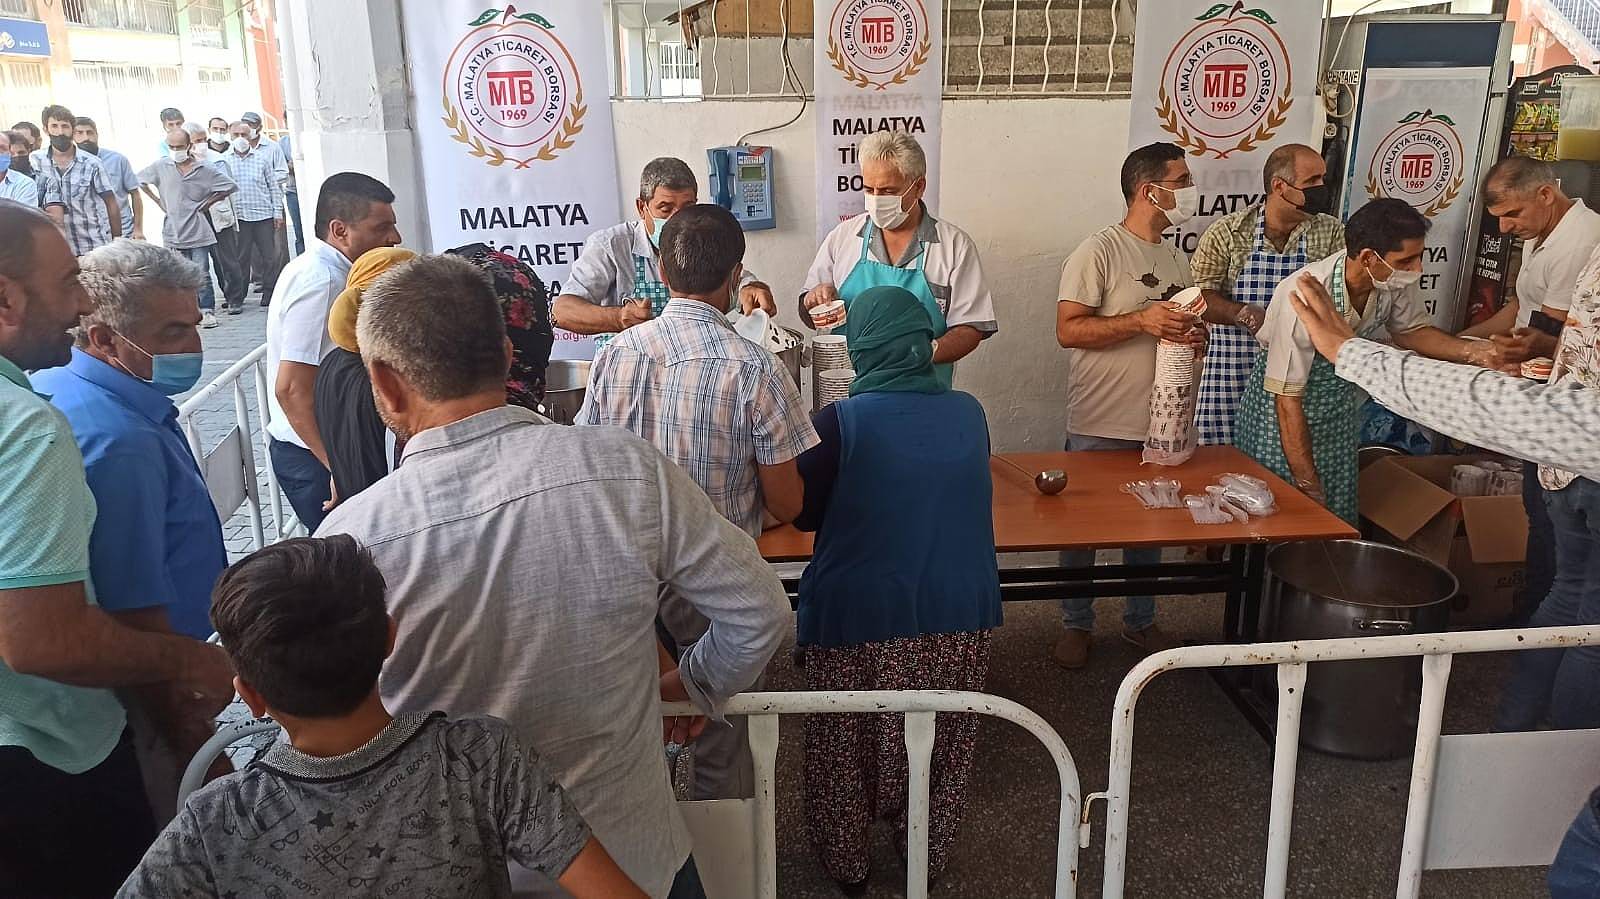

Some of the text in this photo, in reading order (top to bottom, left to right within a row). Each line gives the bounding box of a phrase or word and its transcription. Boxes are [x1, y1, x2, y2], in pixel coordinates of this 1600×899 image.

[844, 1, 869, 39] MALATYA
[900, 14, 913, 57] BORSASI
[861, 17, 895, 44] MTB
[868, 46, 888, 55] 1969
[465, 47, 494, 100] MALATYA
[494, 39, 548, 65] TİCARET
[543, 65, 560, 124] BORSASI
[1181, 41, 1215, 91] MALATYA
[1216, 33, 1264, 59] TİCARET
[1250, 59, 1271, 116] BORSASI
[1203, 64, 1248, 98] MTB
[486, 71, 535, 106] MTB
[500, 109, 527, 121] 1969
[1210, 101, 1237, 112] 1969
[832, 116, 926, 136] MALATYA
[1384, 137, 1411, 175] MALATYA
[1412, 132, 1446, 151] TİCARET
[1433, 150, 1450, 191] BORSASI
[1400, 154, 1434, 179] MTB
[1405, 180, 1425, 189] 1969
[459, 203, 589, 231] MALATYA
[1192, 194, 1268, 217] LATY
[489, 240, 584, 266] CARET
[356, 790, 384, 816] ONLY
[384, 772, 406, 793] FOR
[406, 751, 433, 774] BOYS
[292, 878, 321, 897] BOYS
